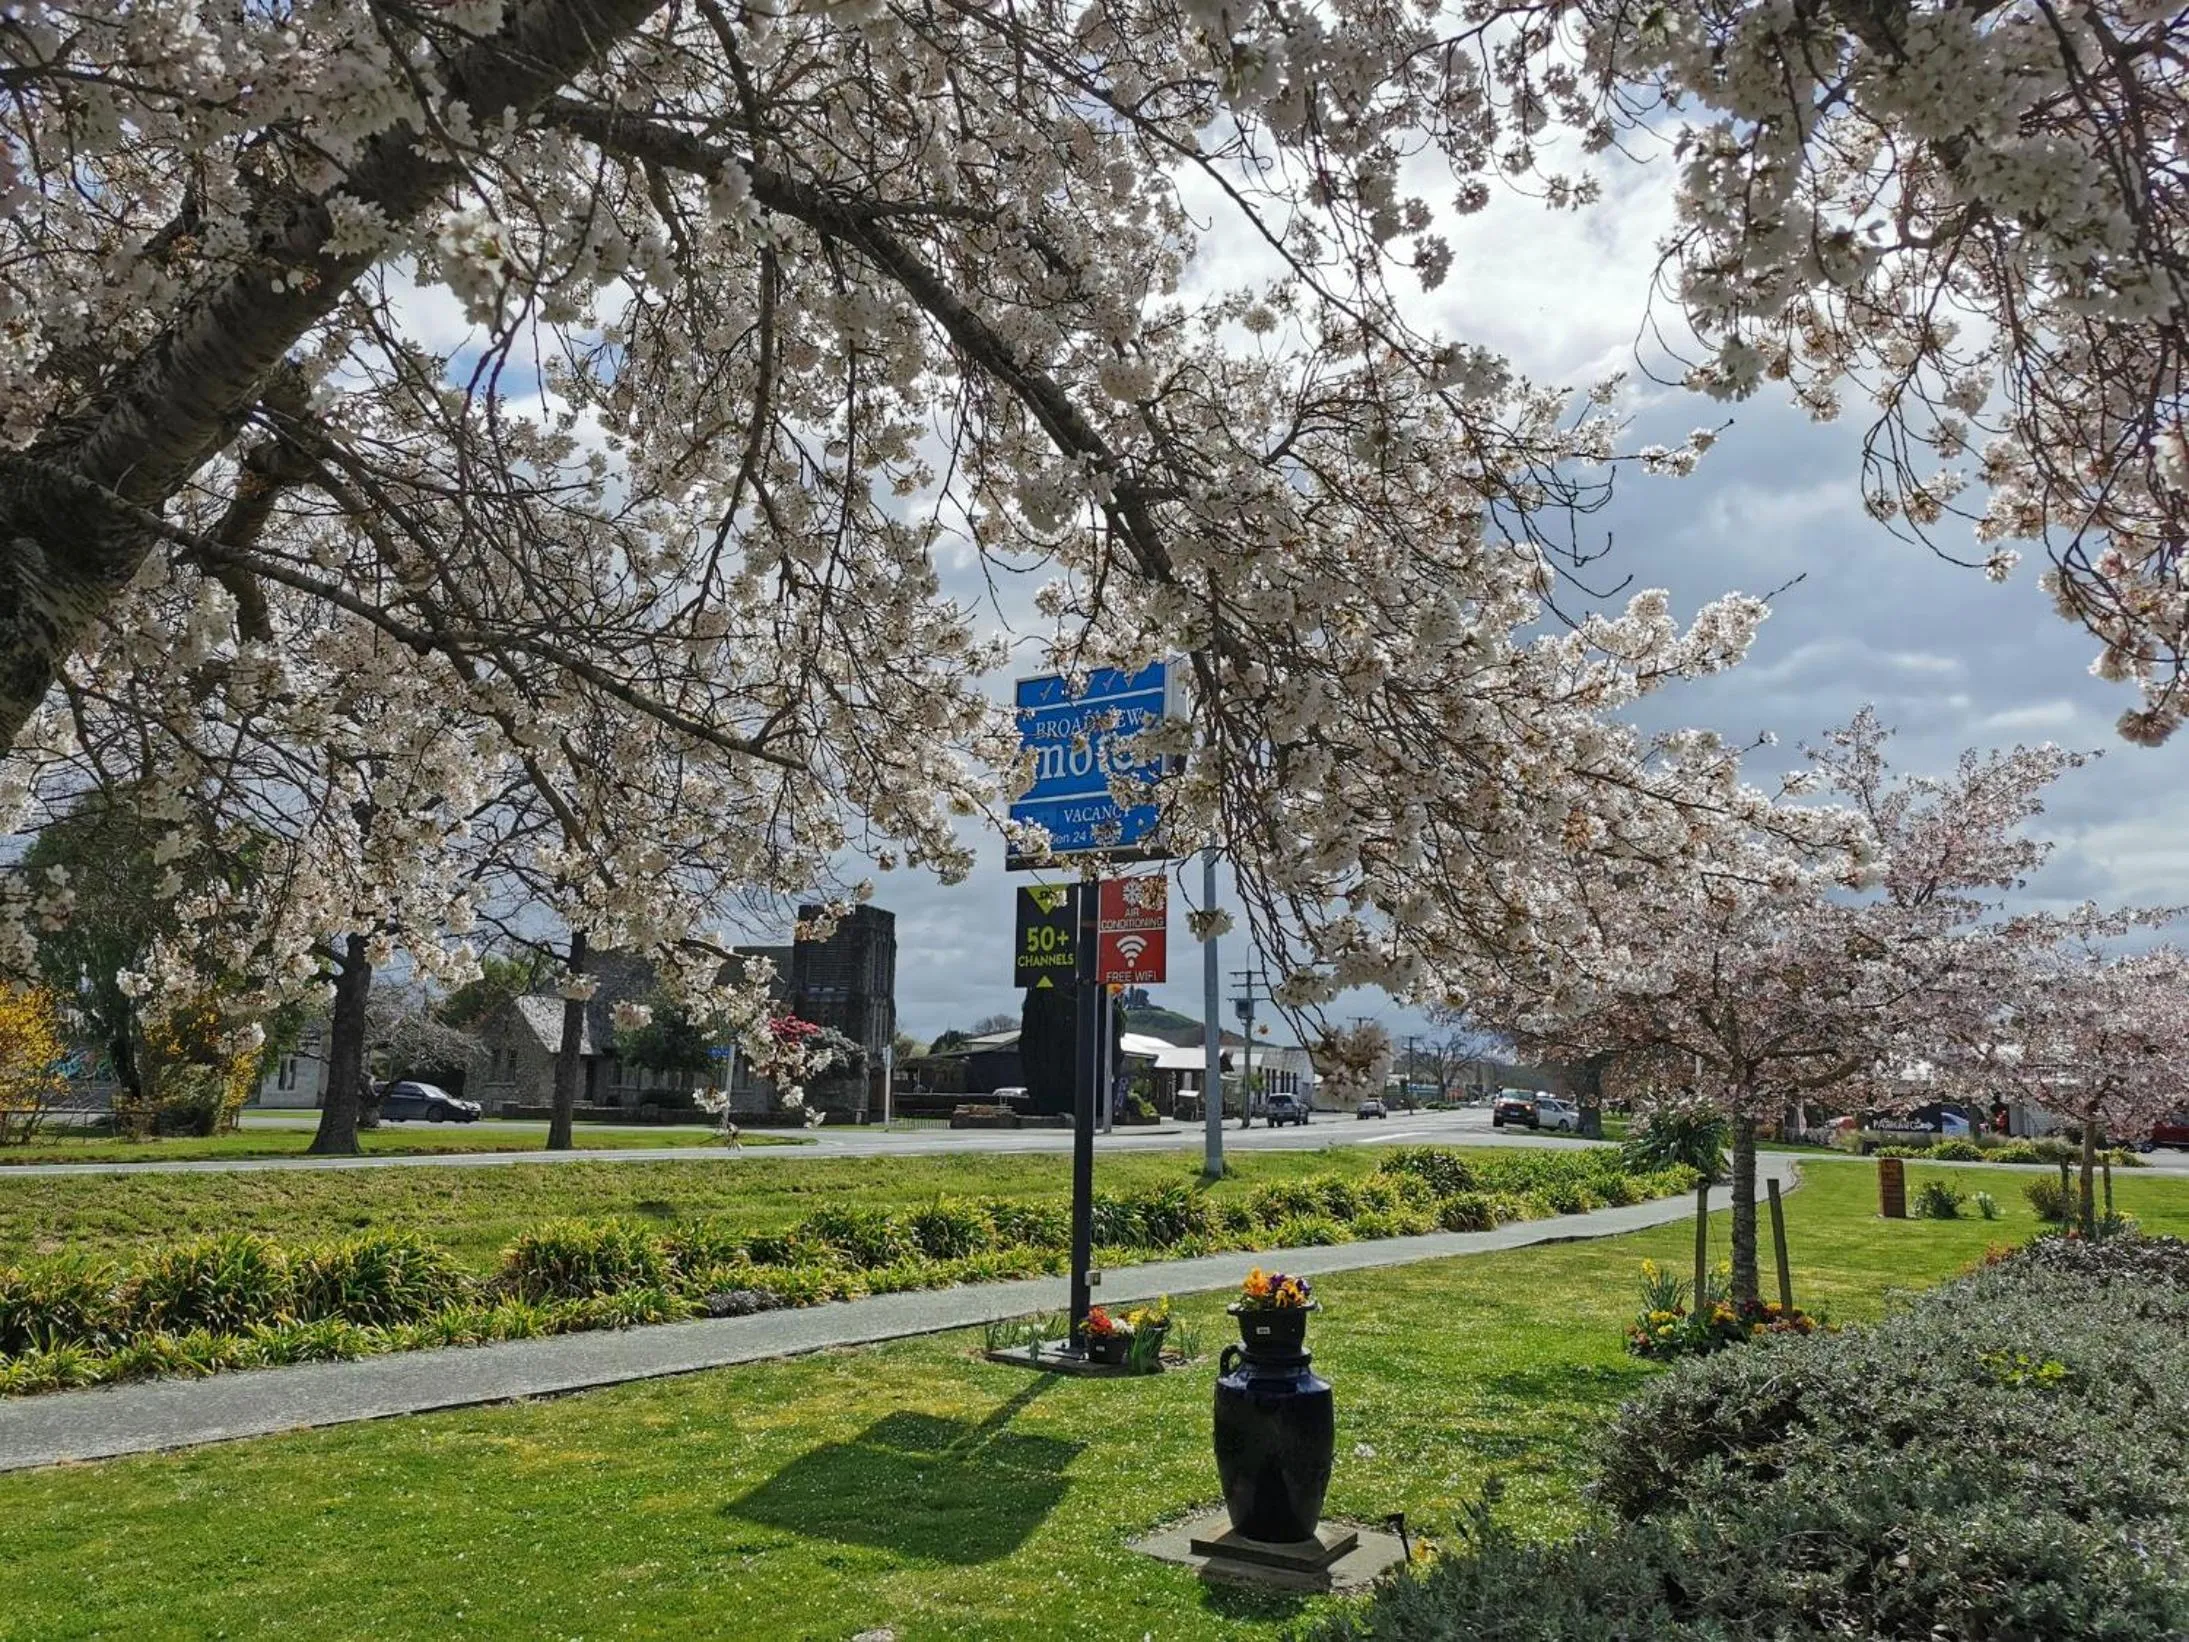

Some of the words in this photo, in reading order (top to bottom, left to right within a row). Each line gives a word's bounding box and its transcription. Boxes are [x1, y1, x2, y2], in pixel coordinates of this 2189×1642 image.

[1036, 706, 1144, 739] BROADEW
[1124, 906, 1140, 917] AIR
[1026, 925, 1069, 952] 50+
[1017, 952, 1074, 968] CHANNELS
[1105, 970, 1132, 983] FREE
[1134, 969, 1157, 982] WIFI
